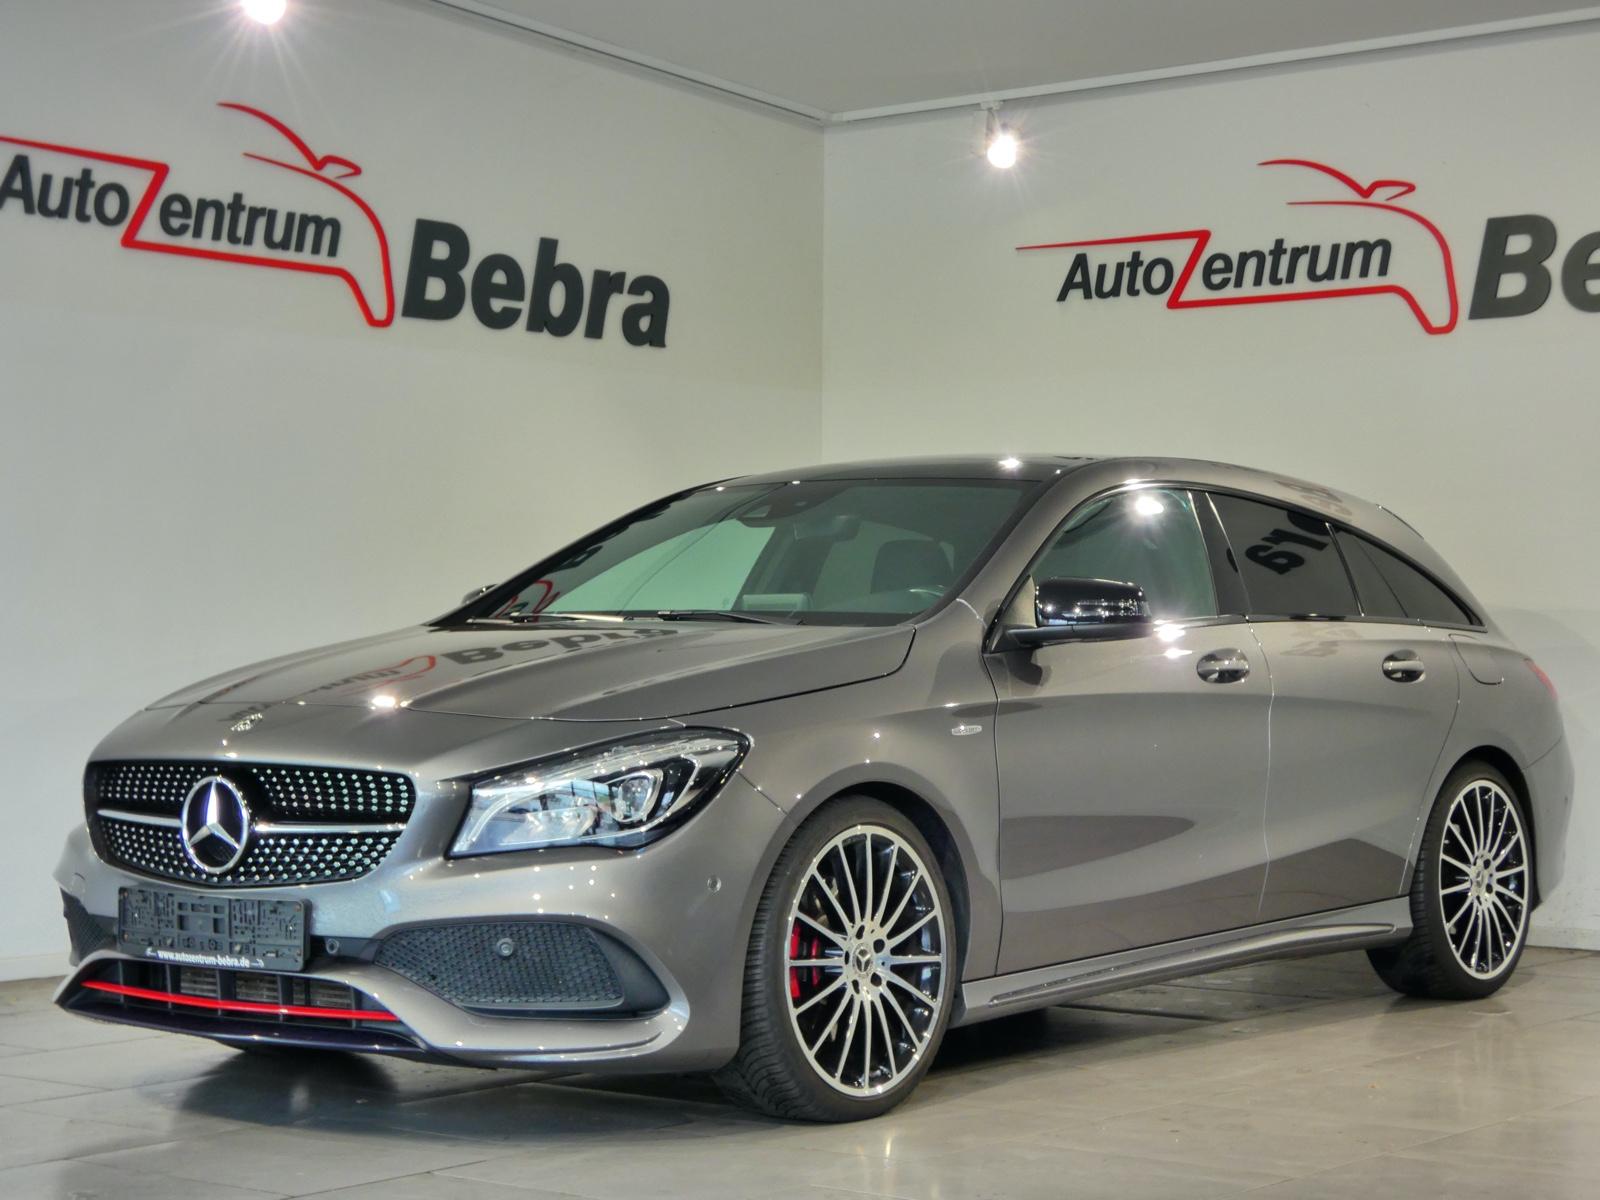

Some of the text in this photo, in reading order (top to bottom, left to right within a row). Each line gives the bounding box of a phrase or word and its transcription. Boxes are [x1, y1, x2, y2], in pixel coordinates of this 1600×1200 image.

[401, 218, 671, 348] Bebra
[1056, 214, 1600, 320] AutoZentrum Be
[157, 949, 250, 968] www.autozentrum-bebra.de
